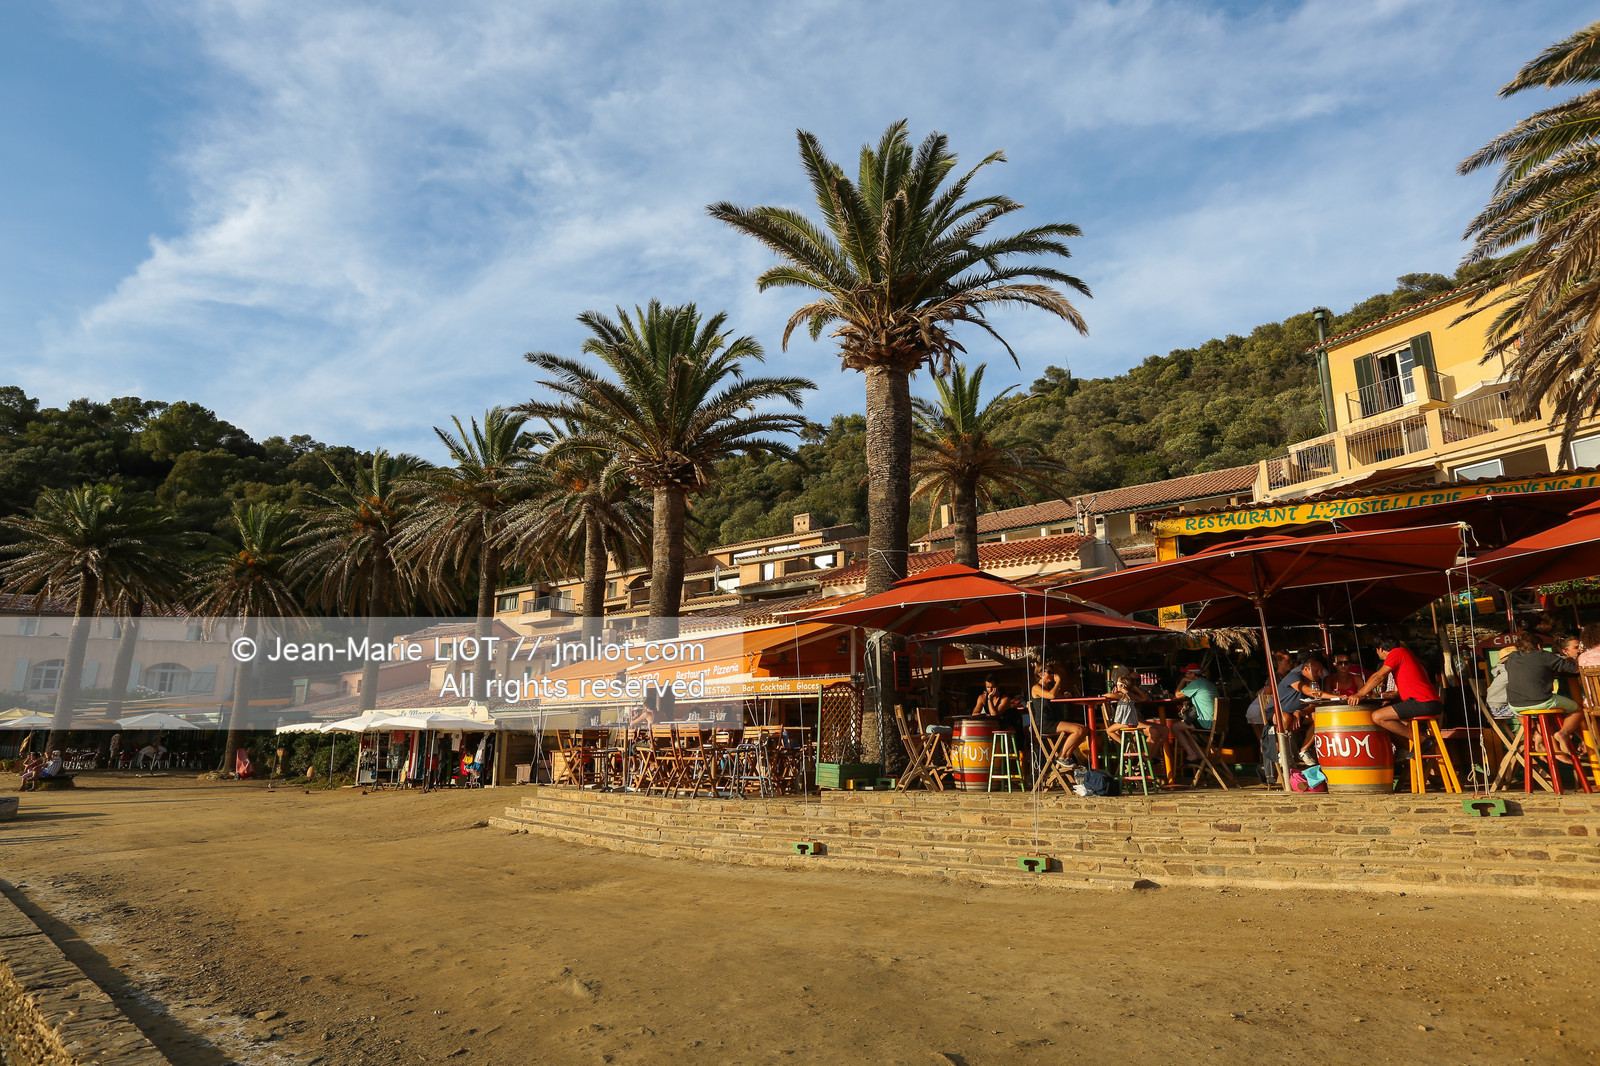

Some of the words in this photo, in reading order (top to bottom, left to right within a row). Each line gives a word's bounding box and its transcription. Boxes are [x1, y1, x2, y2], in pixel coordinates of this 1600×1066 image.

[1185, 507, 1300, 531] RESTAURANT
[1493, 635, 1519, 645] CAR
[712, 662, 740, 675] Pizzeria
[705, 685, 731, 695] BISTRO
[742, 684, 755, 692] Bar
[760, 682, 791, 692] Cocktails
[796, 681, 820, 690] Glaces
[951, 744, 990, 762] RHUM
[1315, 734, 1375, 759] RHUM
